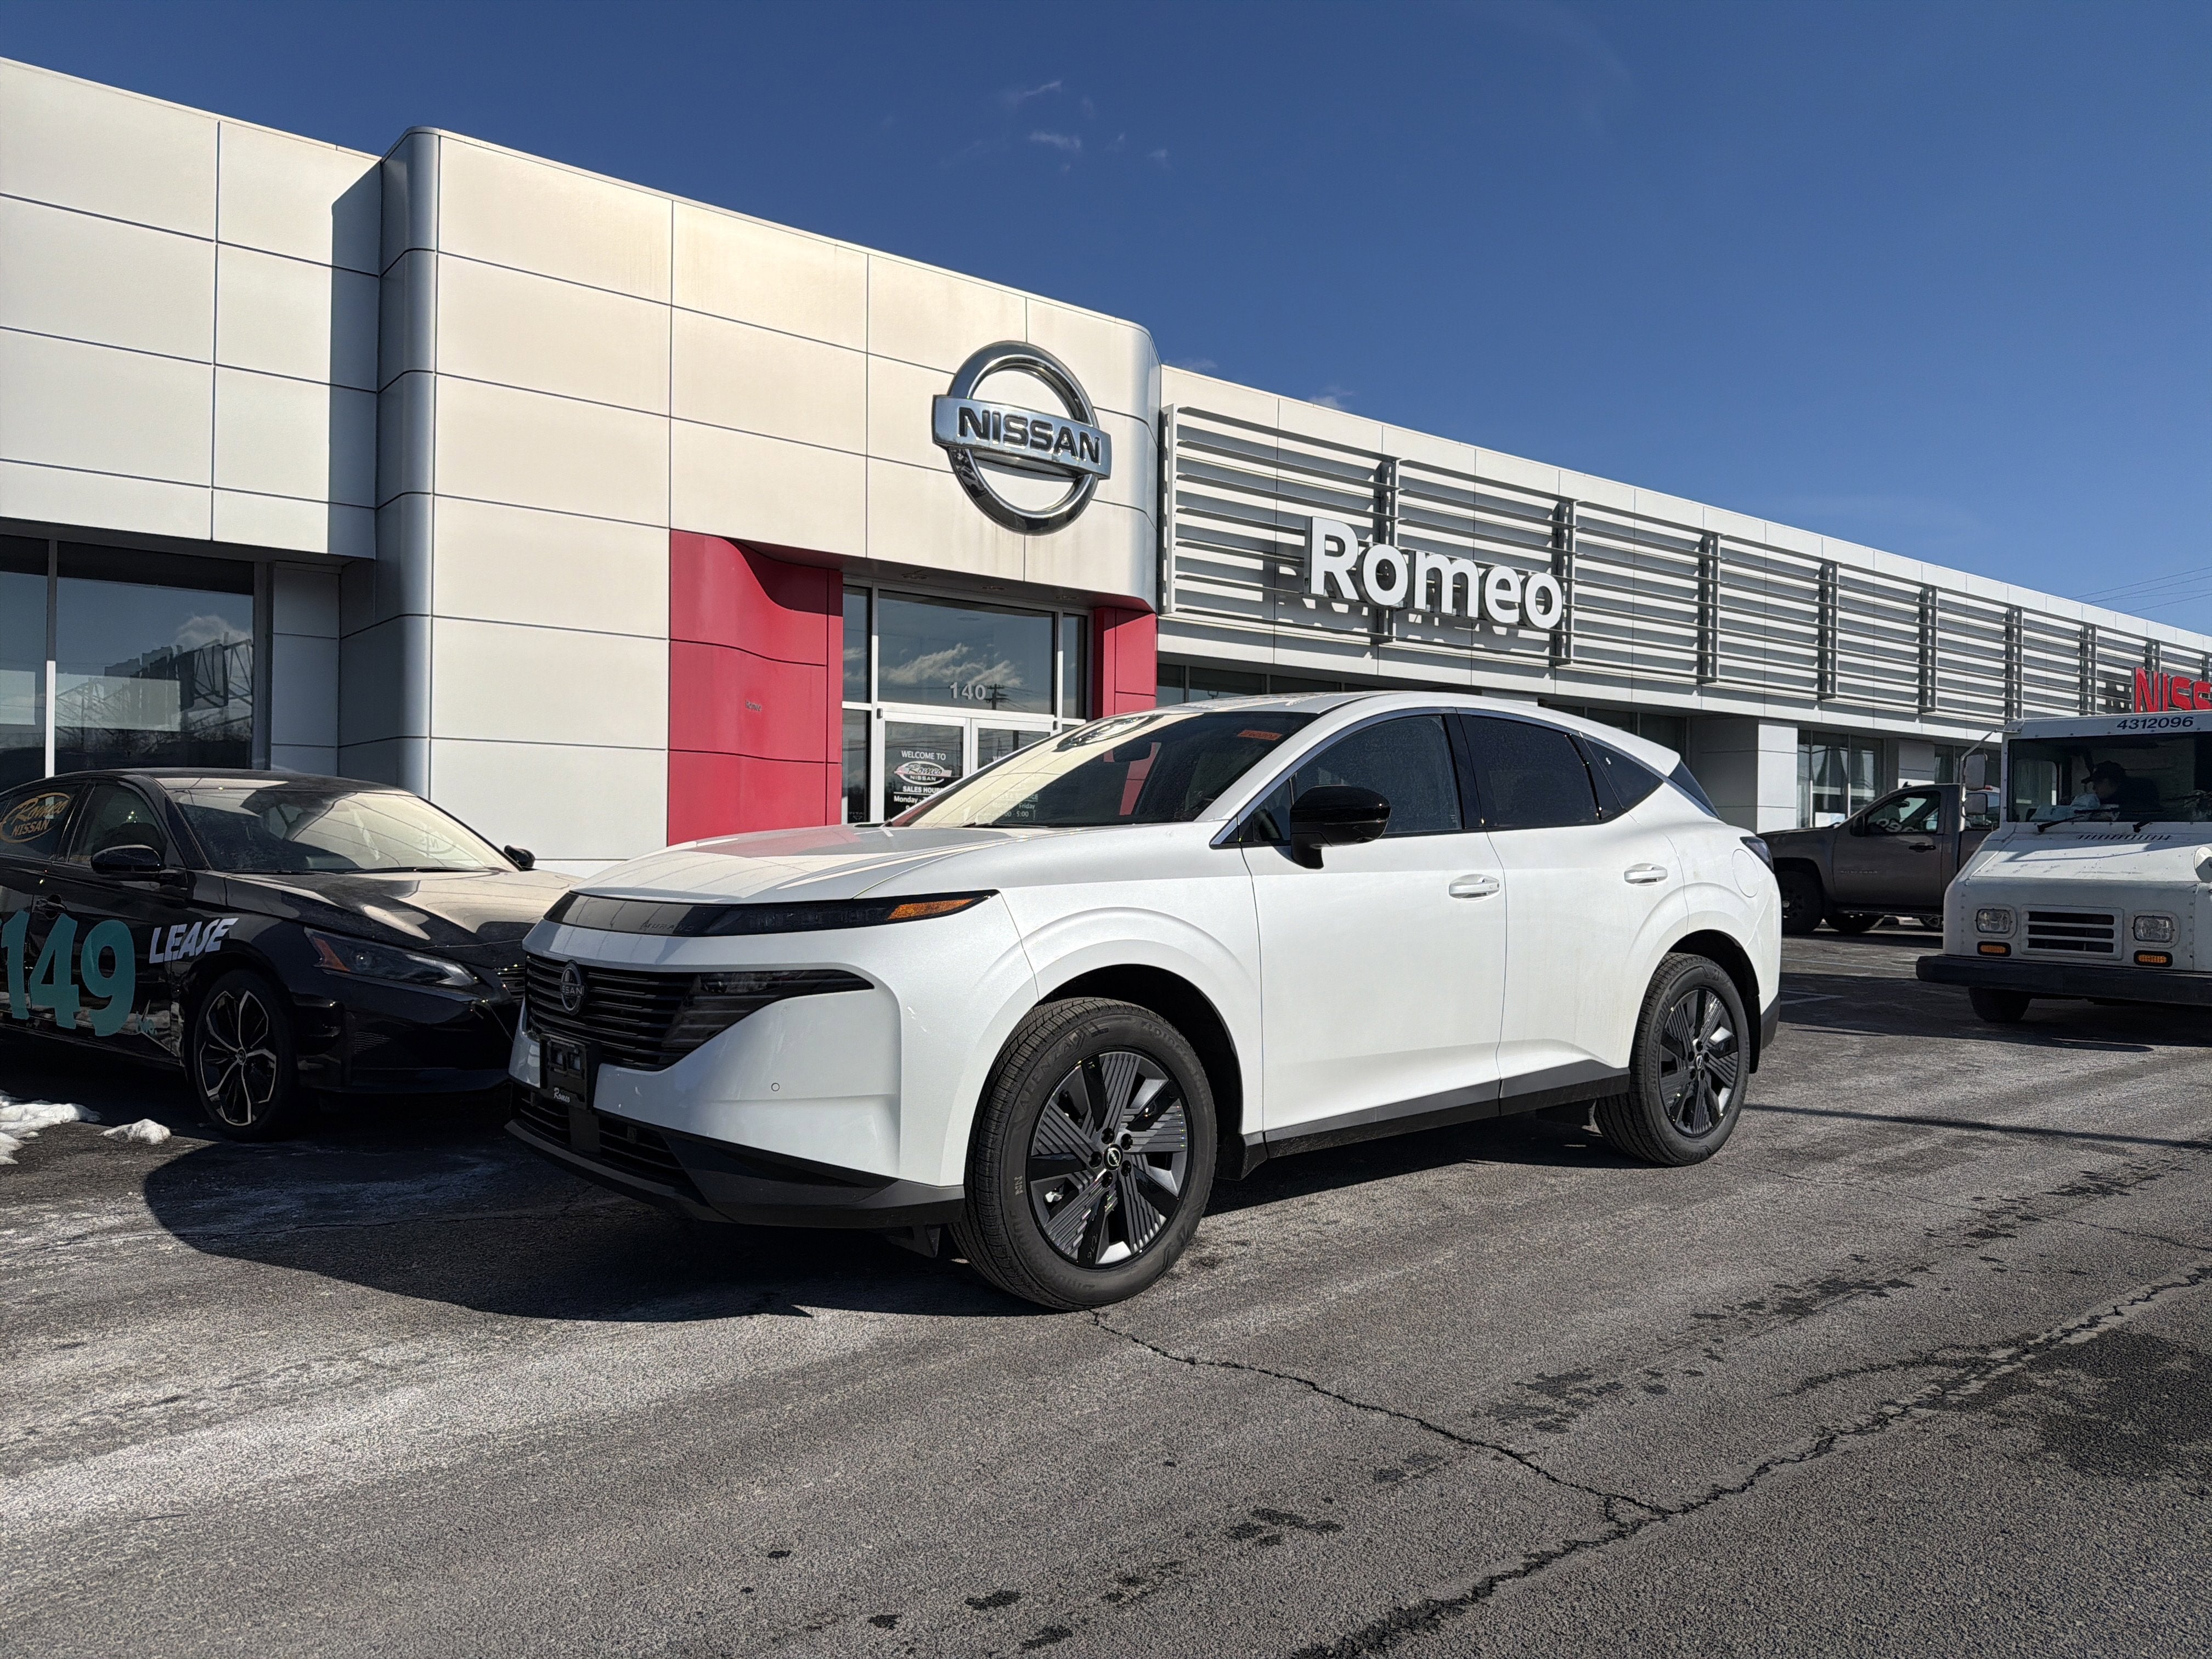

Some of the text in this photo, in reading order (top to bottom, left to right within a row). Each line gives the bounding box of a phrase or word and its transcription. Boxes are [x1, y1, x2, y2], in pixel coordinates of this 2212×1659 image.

[958, 407, 1102, 465] NISSAN
[1310, 516, 1562, 629] Romeo
[950, 681, 986, 701] 140
[2117, 716, 2194, 730] 4312096
[901, 751, 935, 759] WELCOME
[906, 763, 943, 775] Romeo
[10, 798, 69, 825] Romeo
[12, 819, 50, 837] NISSAN
[643, 923, 694, 932] MURANO
[149, 918, 239, 964] LEASE
[0, 909, 136, 1037] 149
[561, 985, 583, 995] SSAN
[554, 1087, 571, 1103] Romeo
